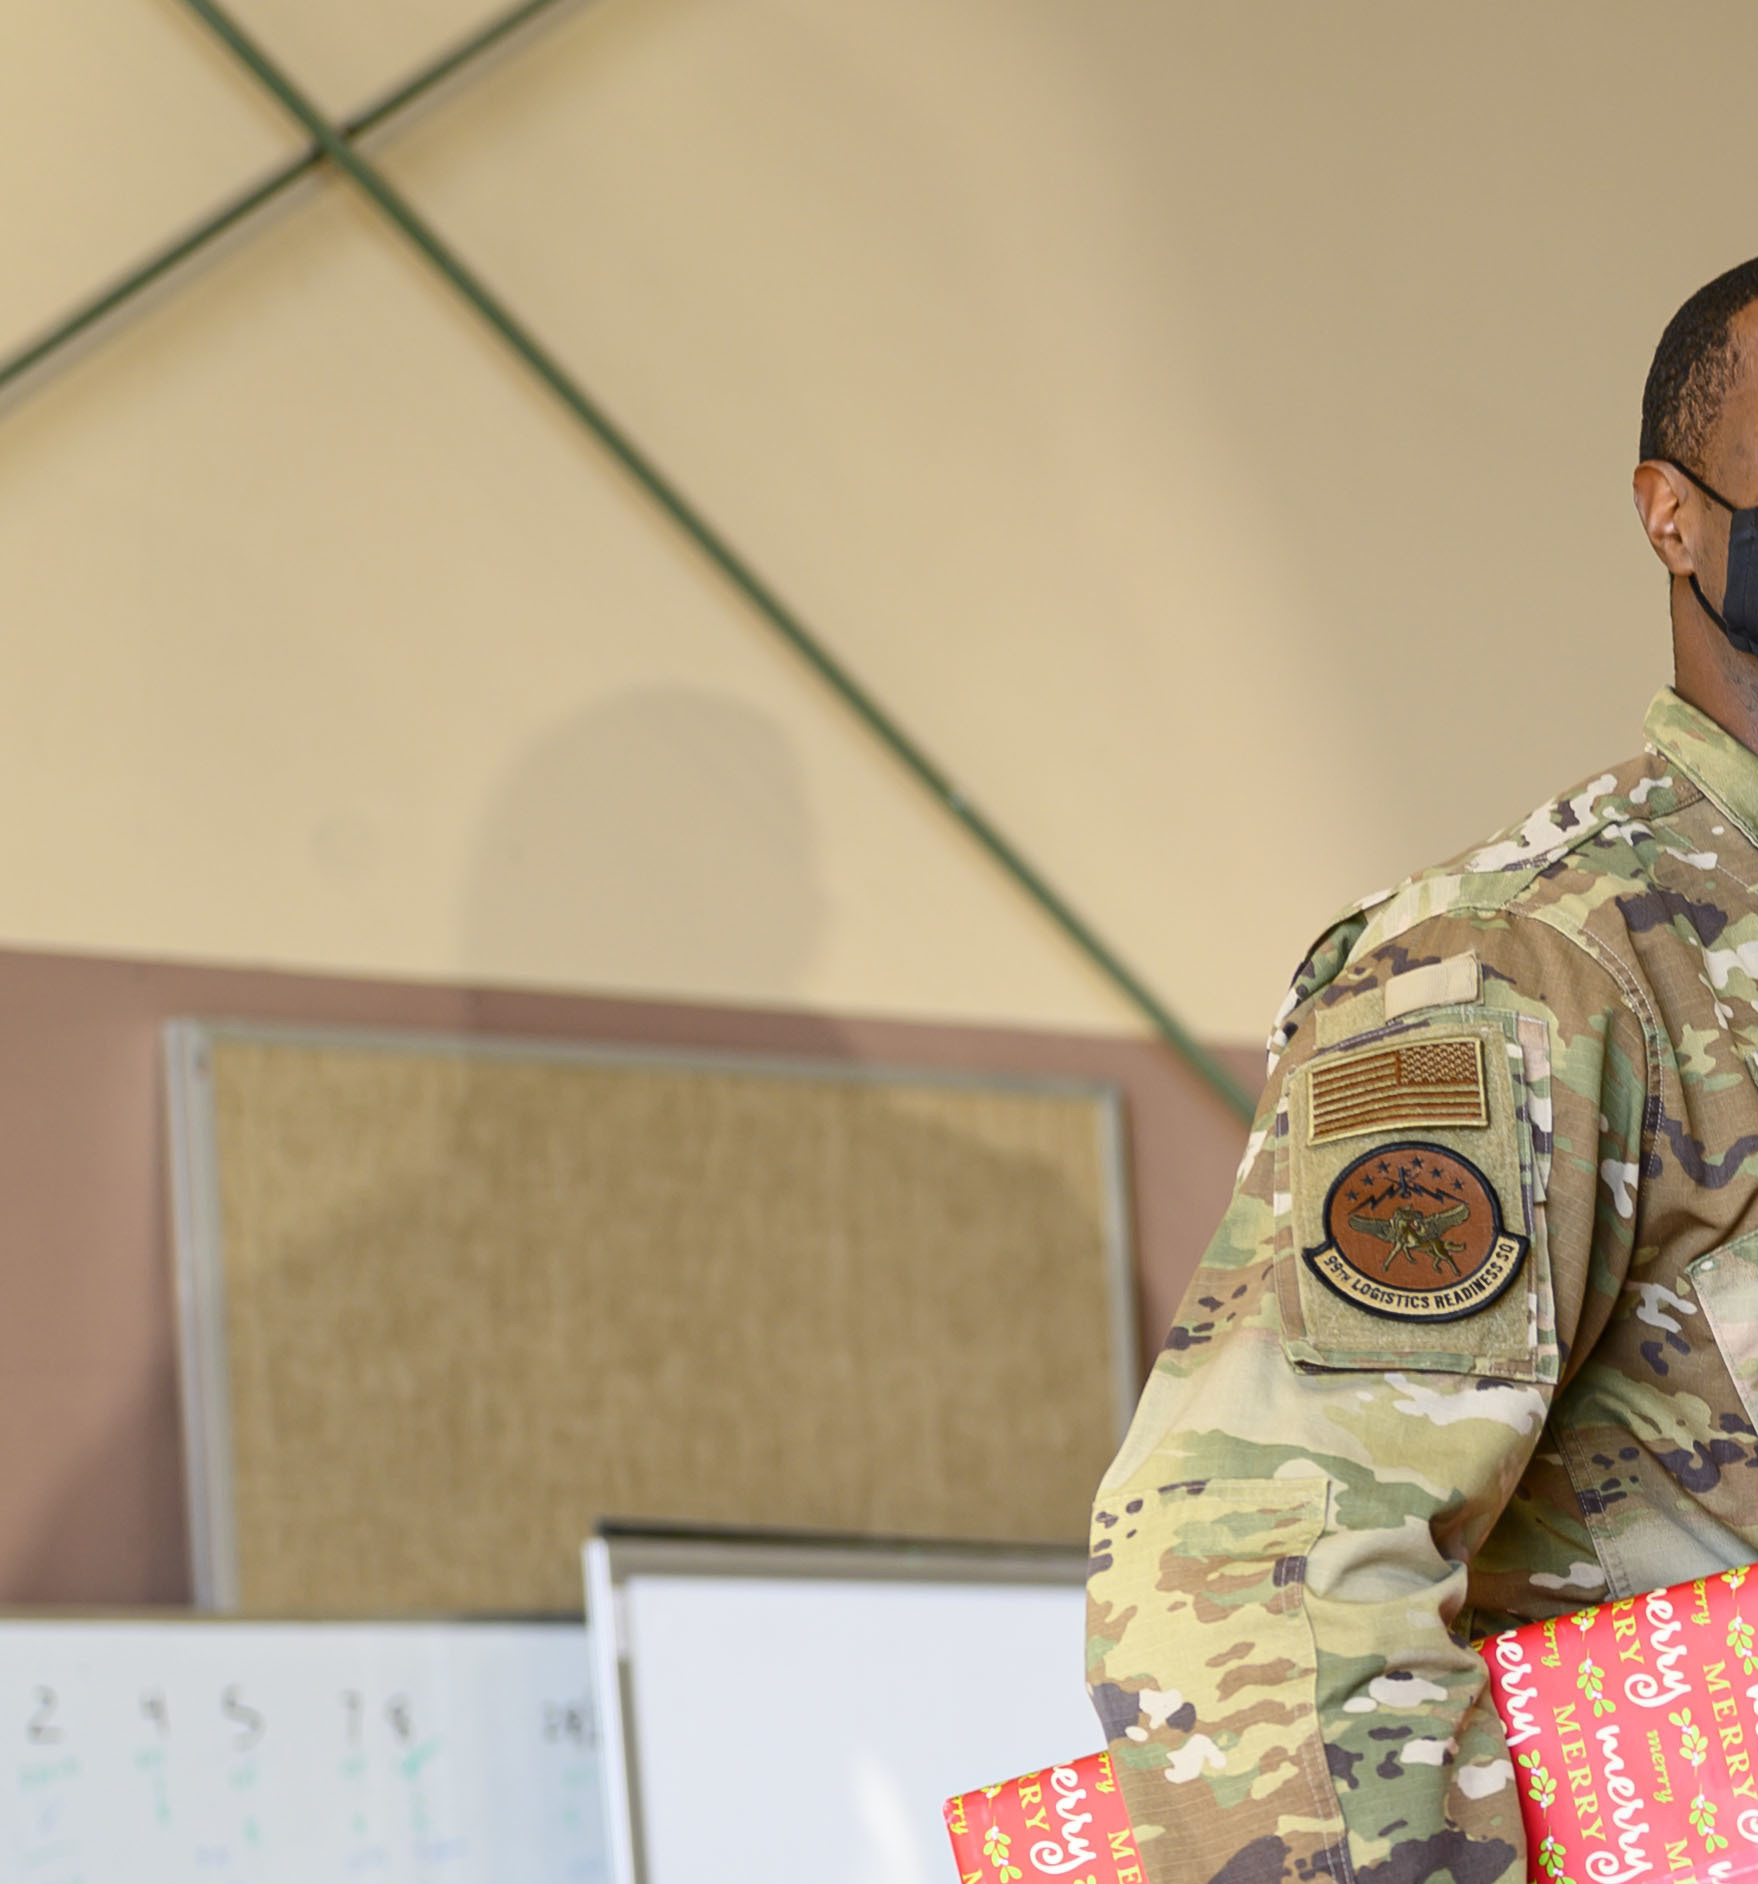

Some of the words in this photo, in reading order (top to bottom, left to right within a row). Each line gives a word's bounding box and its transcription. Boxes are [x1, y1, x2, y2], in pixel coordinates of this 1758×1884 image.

[1351, 1277, 1430, 1309] LOGISTICS
[1435, 1260, 1502, 1309] READINESS
[1499, 1242, 1516, 1263] SQ
[1029, 1760, 1097, 1875] erry
[1553, 1702, 1606, 1842] MERRY
[1585, 1724, 1653, 1884] merry
[1647, 1730, 1674, 1804] merry
